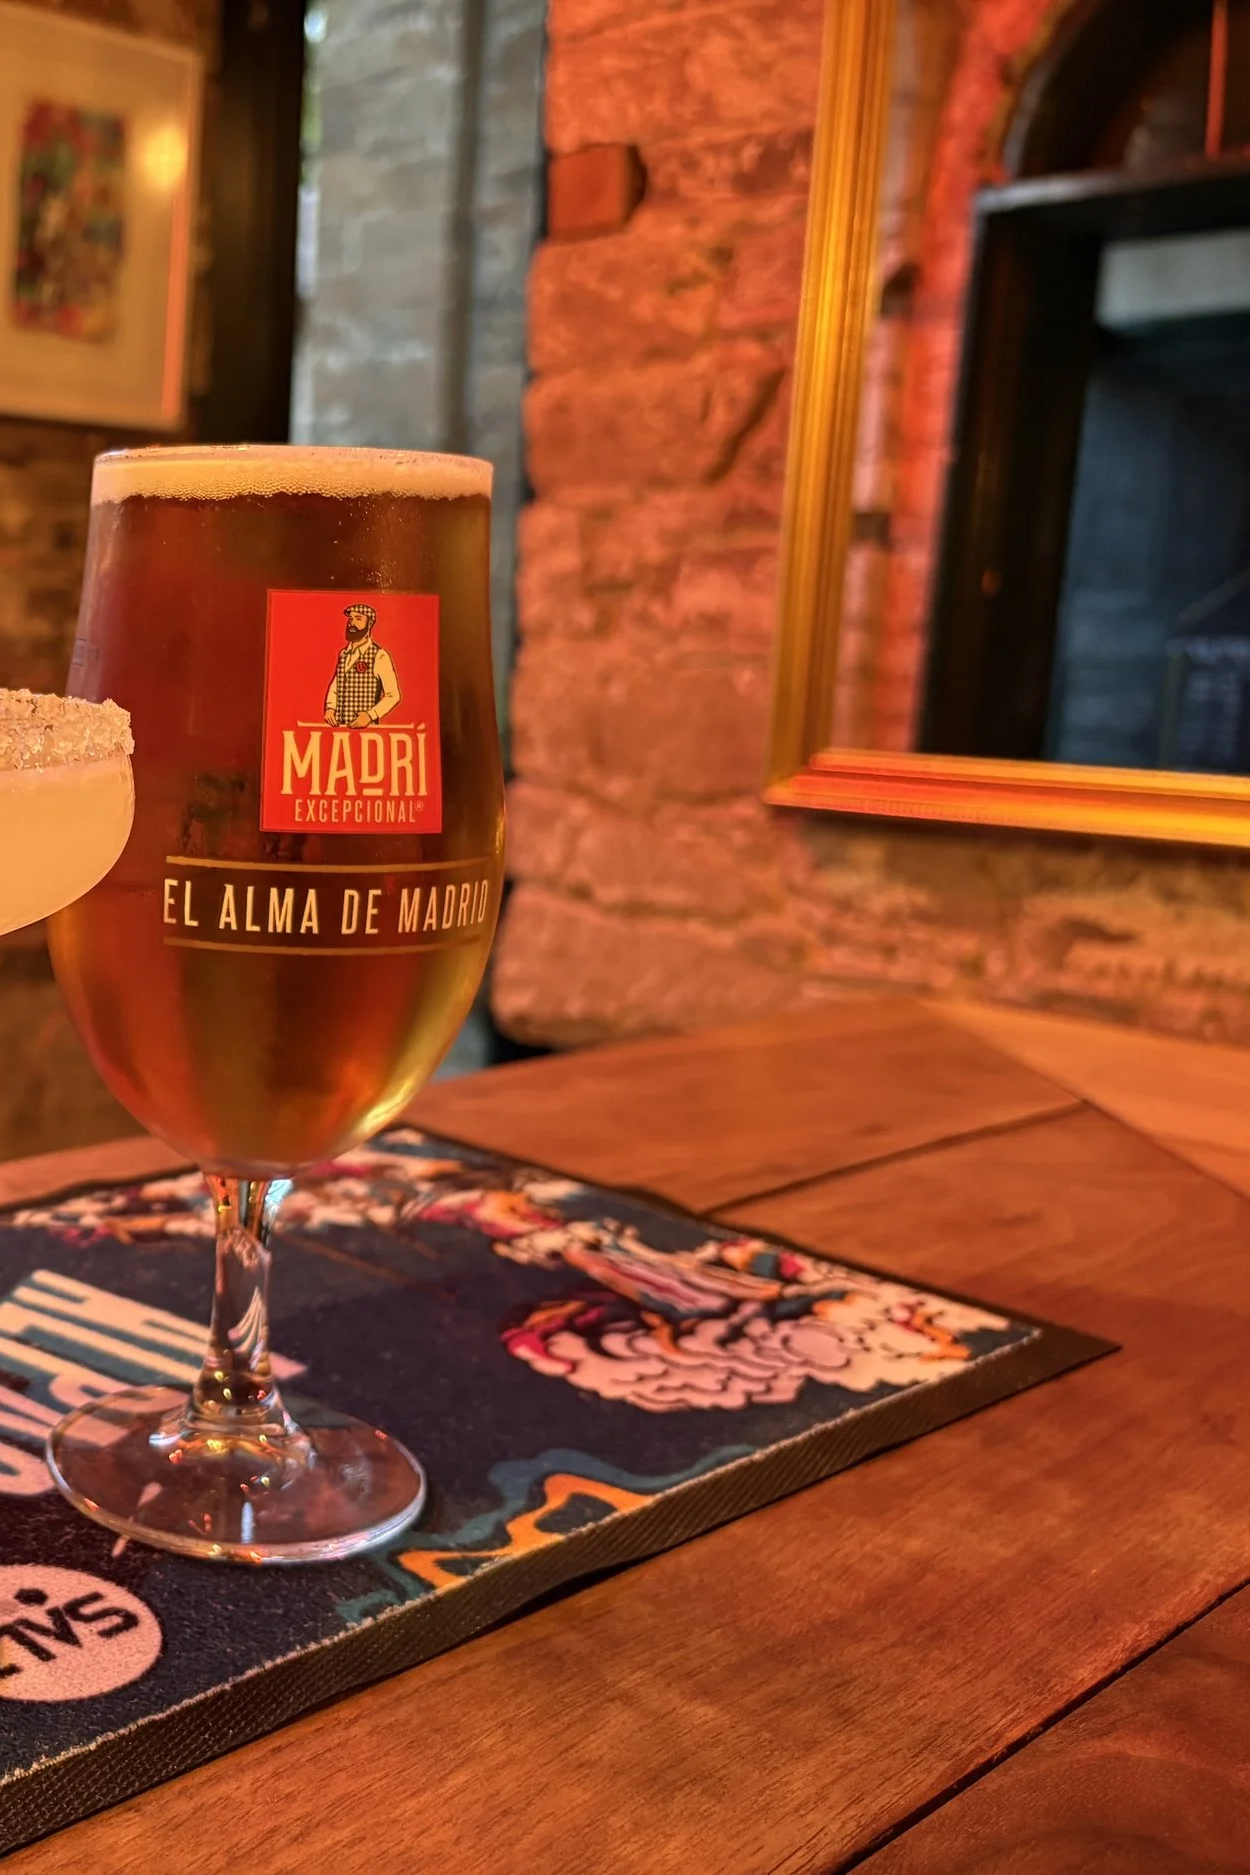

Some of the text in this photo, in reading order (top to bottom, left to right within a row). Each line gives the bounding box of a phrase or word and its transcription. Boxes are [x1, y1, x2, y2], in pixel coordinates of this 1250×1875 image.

[280, 722, 427, 796] MADRÍ
[163, 878, 488, 935] EL ALMA DE MADRID
